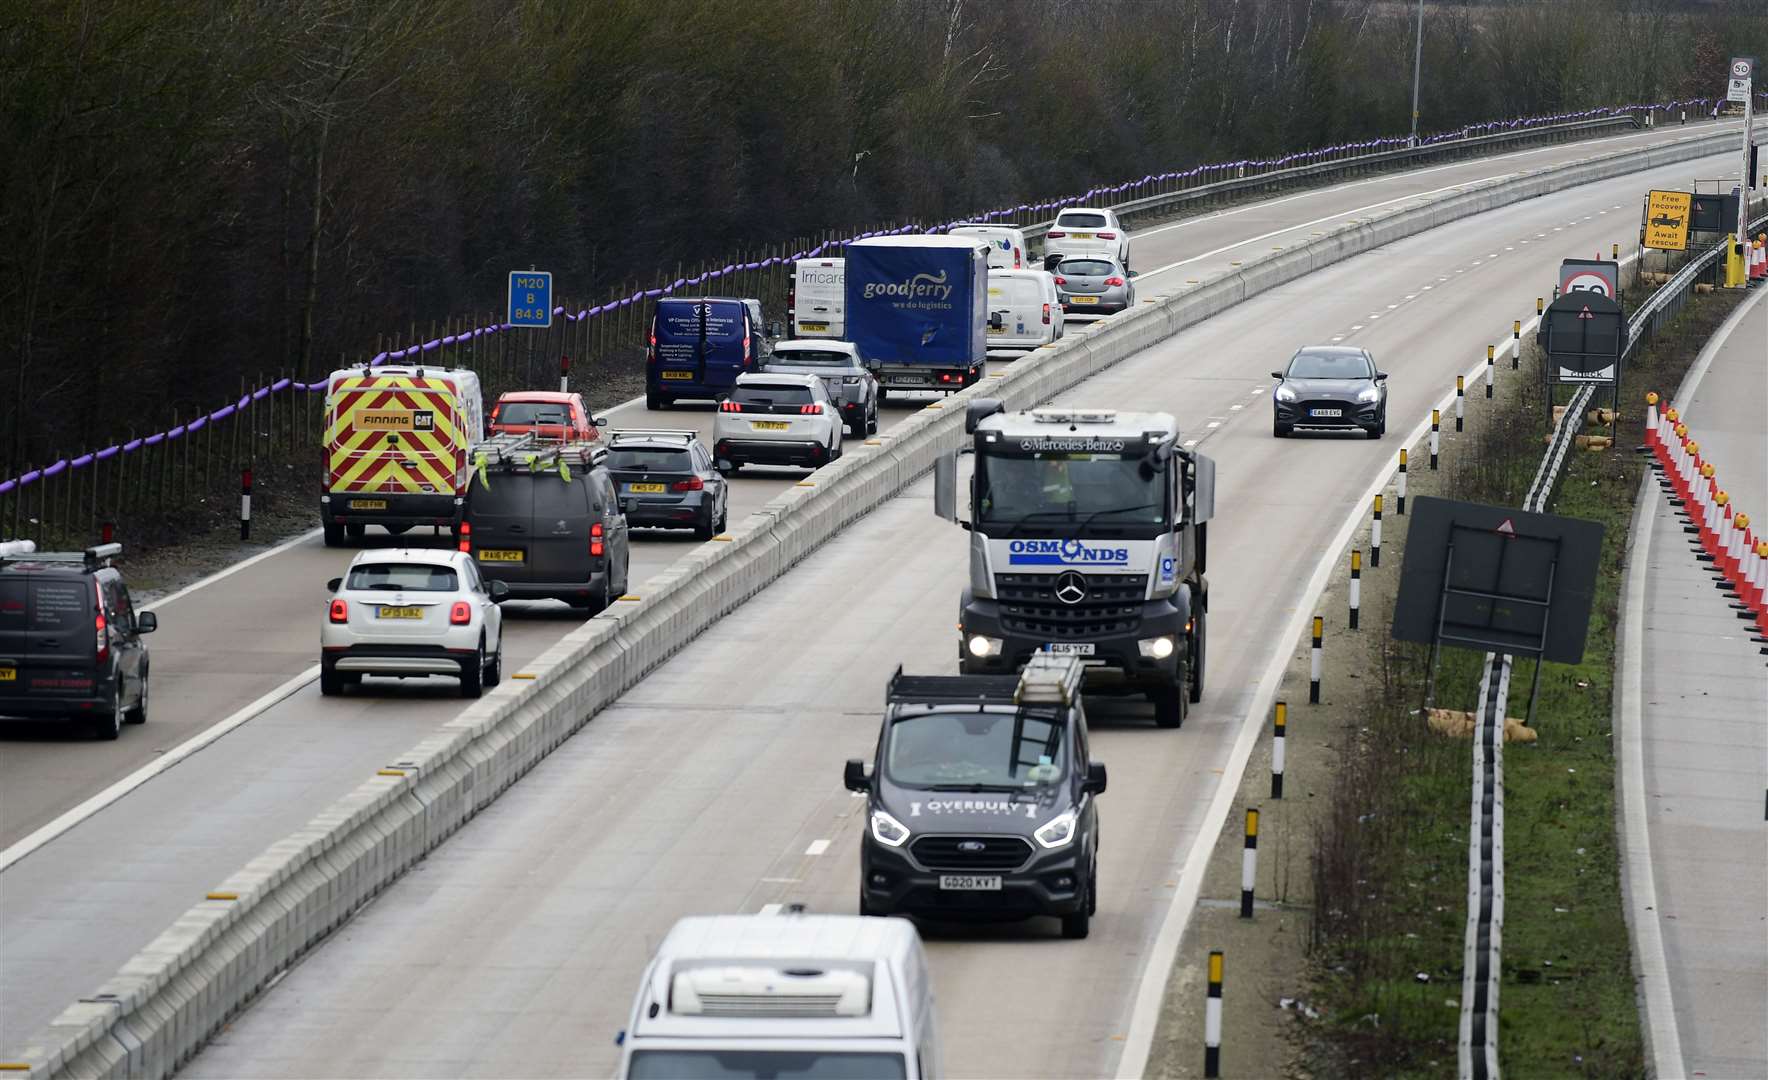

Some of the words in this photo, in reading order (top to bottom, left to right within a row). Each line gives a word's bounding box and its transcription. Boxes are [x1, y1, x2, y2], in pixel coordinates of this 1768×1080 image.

[1735, 65, 1748, 73] 50
[1652, 203, 1687, 212] recovery
[1654, 231, 1678, 239] Await
[802, 270, 844, 284] Irricare
[517, 278, 544, 288] M20
[864, 269, 952, 300] goodferry
[527, 293, 534, 303] B
[918, 301, 952, 310] logistics
[515, 308, 543, 319] 84.8
[364, 416, 409, 424] FINNING
[415, 415, 432, 426] CAT
[1032, 439, 1112, 451] Mercedes-Benz
[1009, 538, 1128, 562] OSMONDS
[1051, 644, 1070, 653] GL15
[927, 800, 1020, 811] OVERBURY
[944, 877, 974, 888] GD20
[975, 877, 997, 888] KVT
